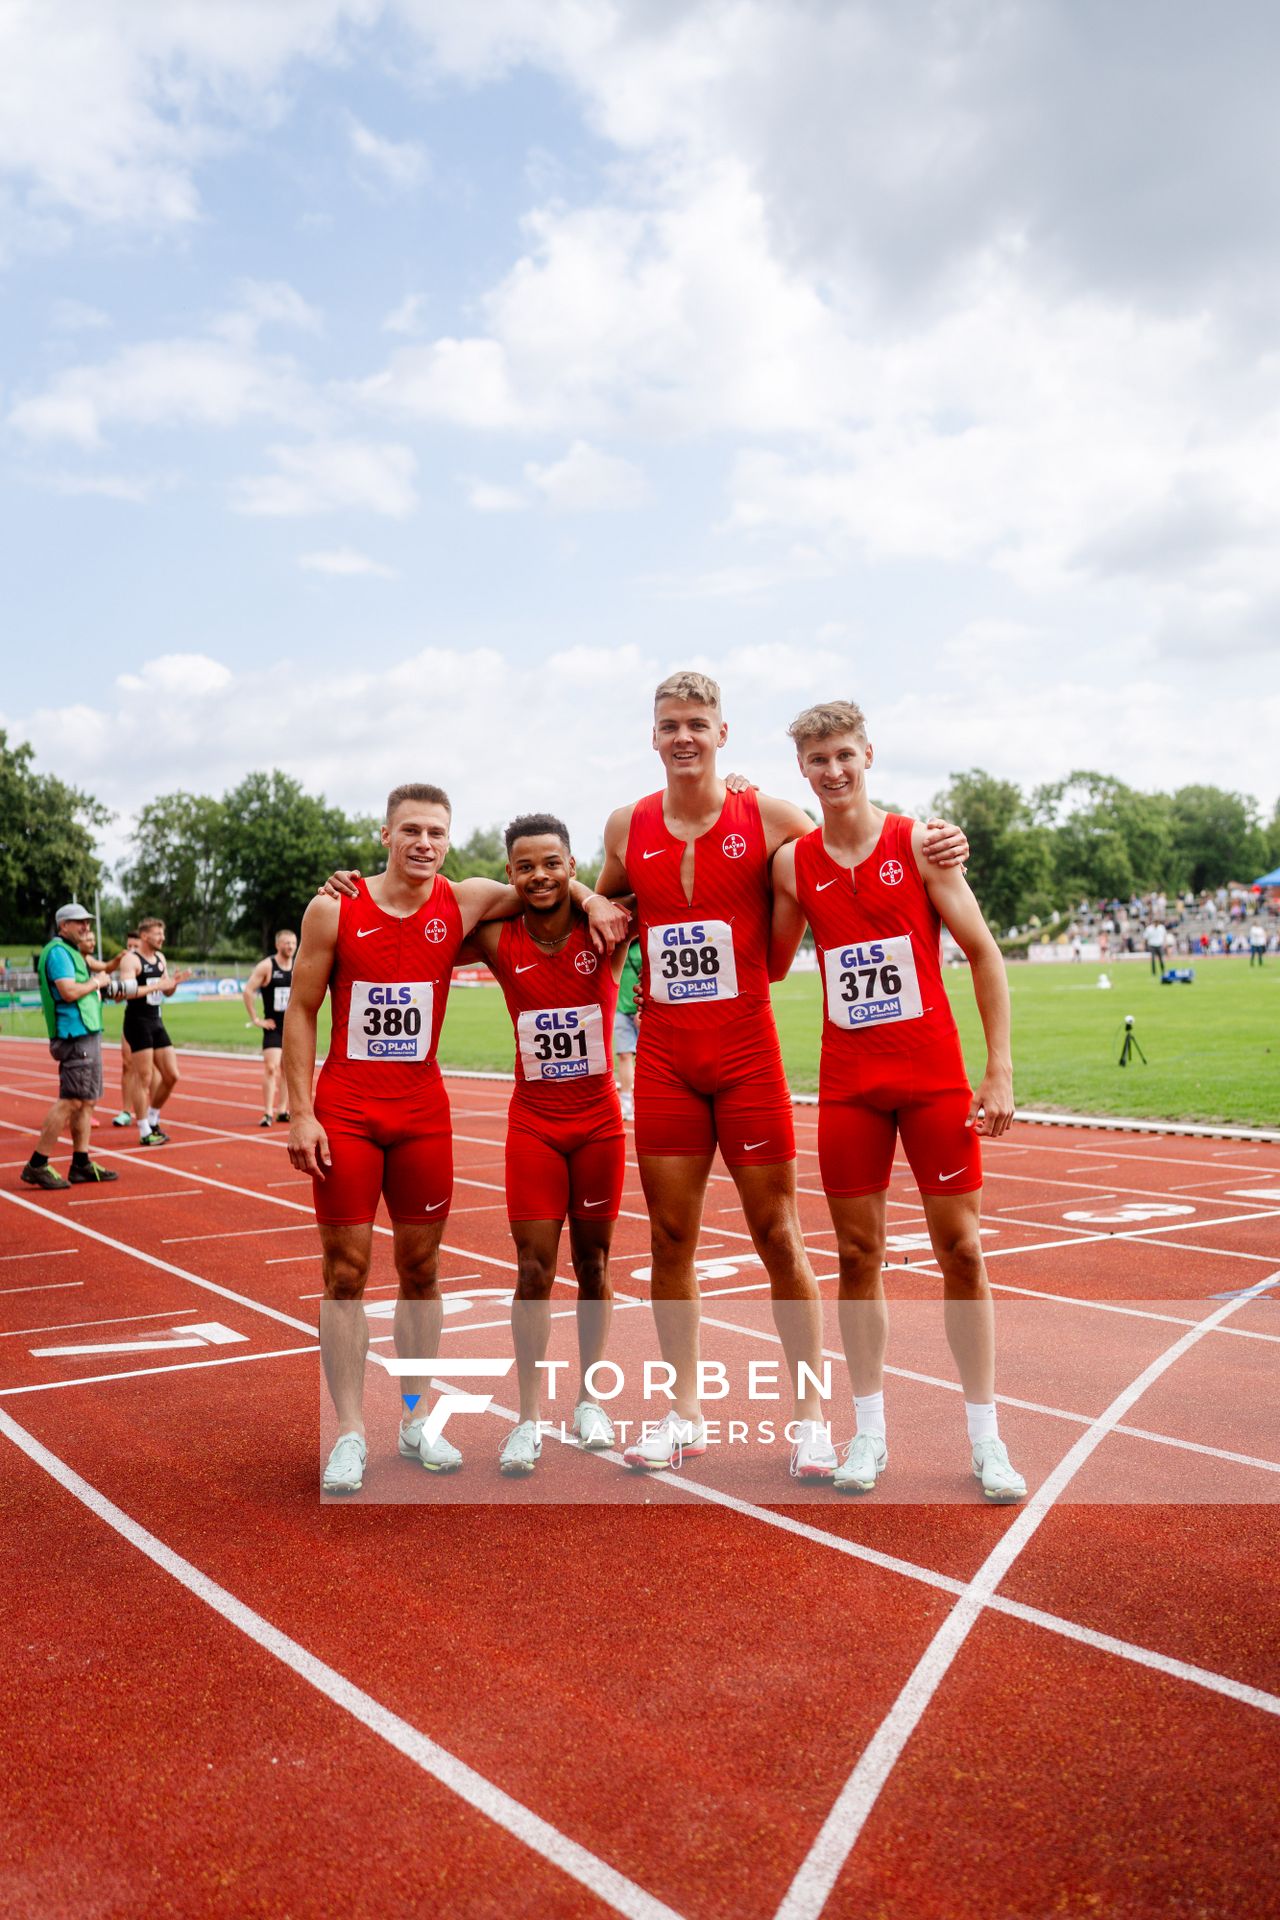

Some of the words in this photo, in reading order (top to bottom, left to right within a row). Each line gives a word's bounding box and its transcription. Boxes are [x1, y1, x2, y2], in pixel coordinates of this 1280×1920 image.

[661, 946, 720, 979] 398
[687, 981, 716, 992] PLAN
[839, 964, 902, 1002] 376
[869, 1001, 899, 1014] PLAN
[363, 1007, 421, 1036] 380
[387, 1042, 416, 1051] PLAN
[534, 1029, 587, 1060] 391
[560, 1062, 587, 1073] PLAN
